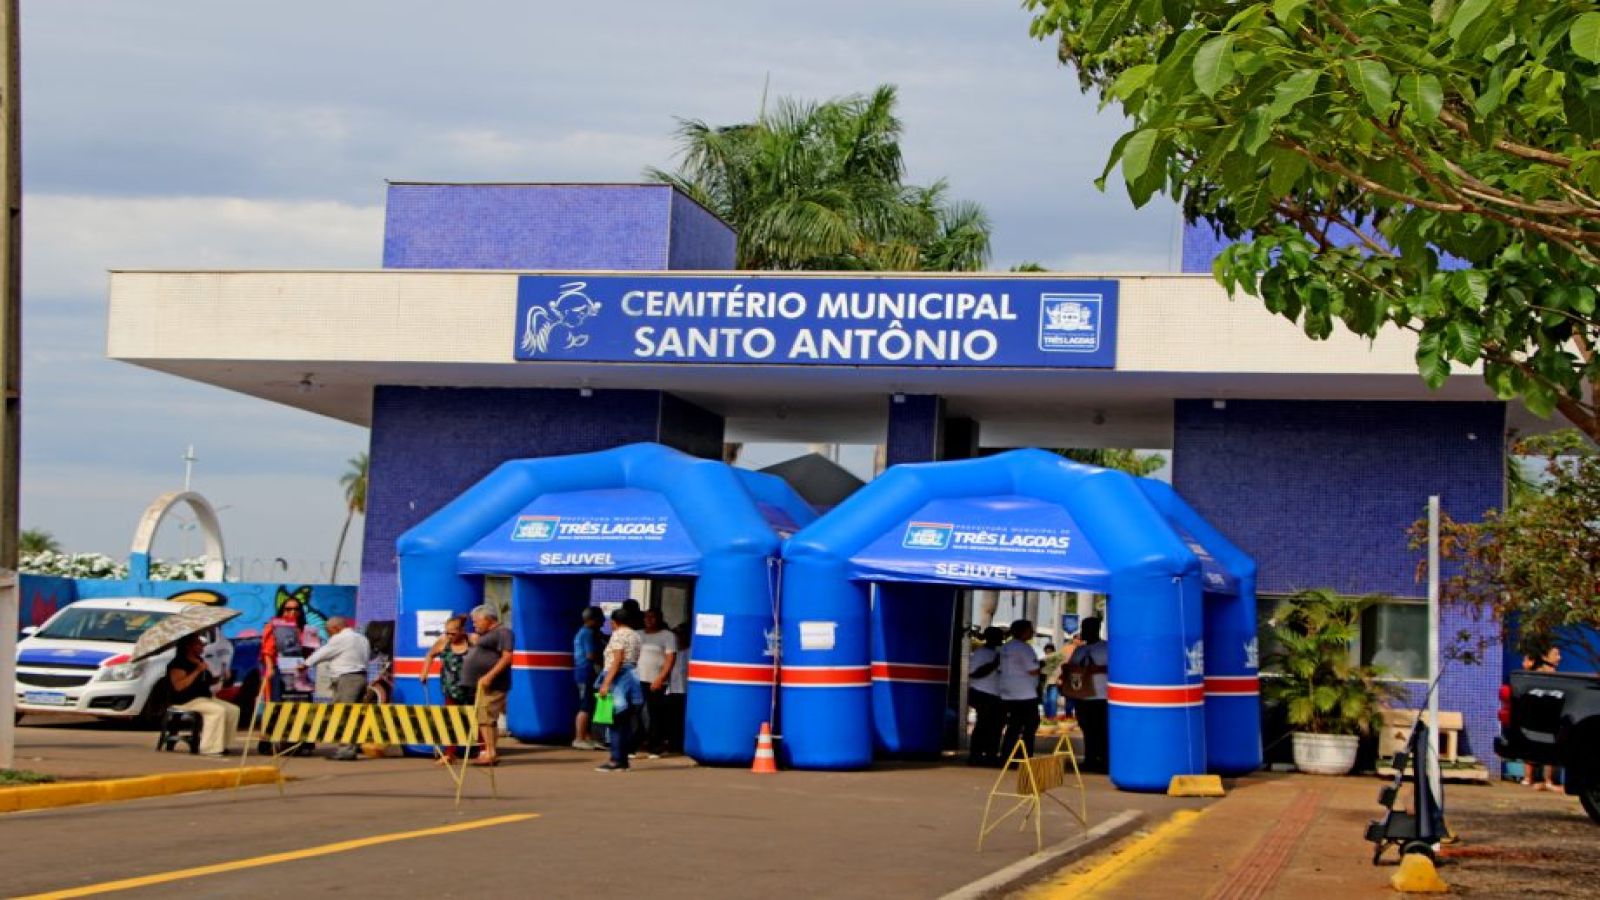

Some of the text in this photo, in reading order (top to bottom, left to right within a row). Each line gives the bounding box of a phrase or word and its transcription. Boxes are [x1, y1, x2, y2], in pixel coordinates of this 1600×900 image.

[621, 284, 1017, 320] CEMITÉRIO MUNICIPAL
[634, 320, 998, 361] SANTO ANTÔNIO
[559, 521, 668, 534] TRÊS LAGOAS
[953, 530, 1071, 549] TRÊS LAGOAS
[540, 552, 615, 565] SEJUVEL
[935, 562, 1017, 580] SEJUVEL
